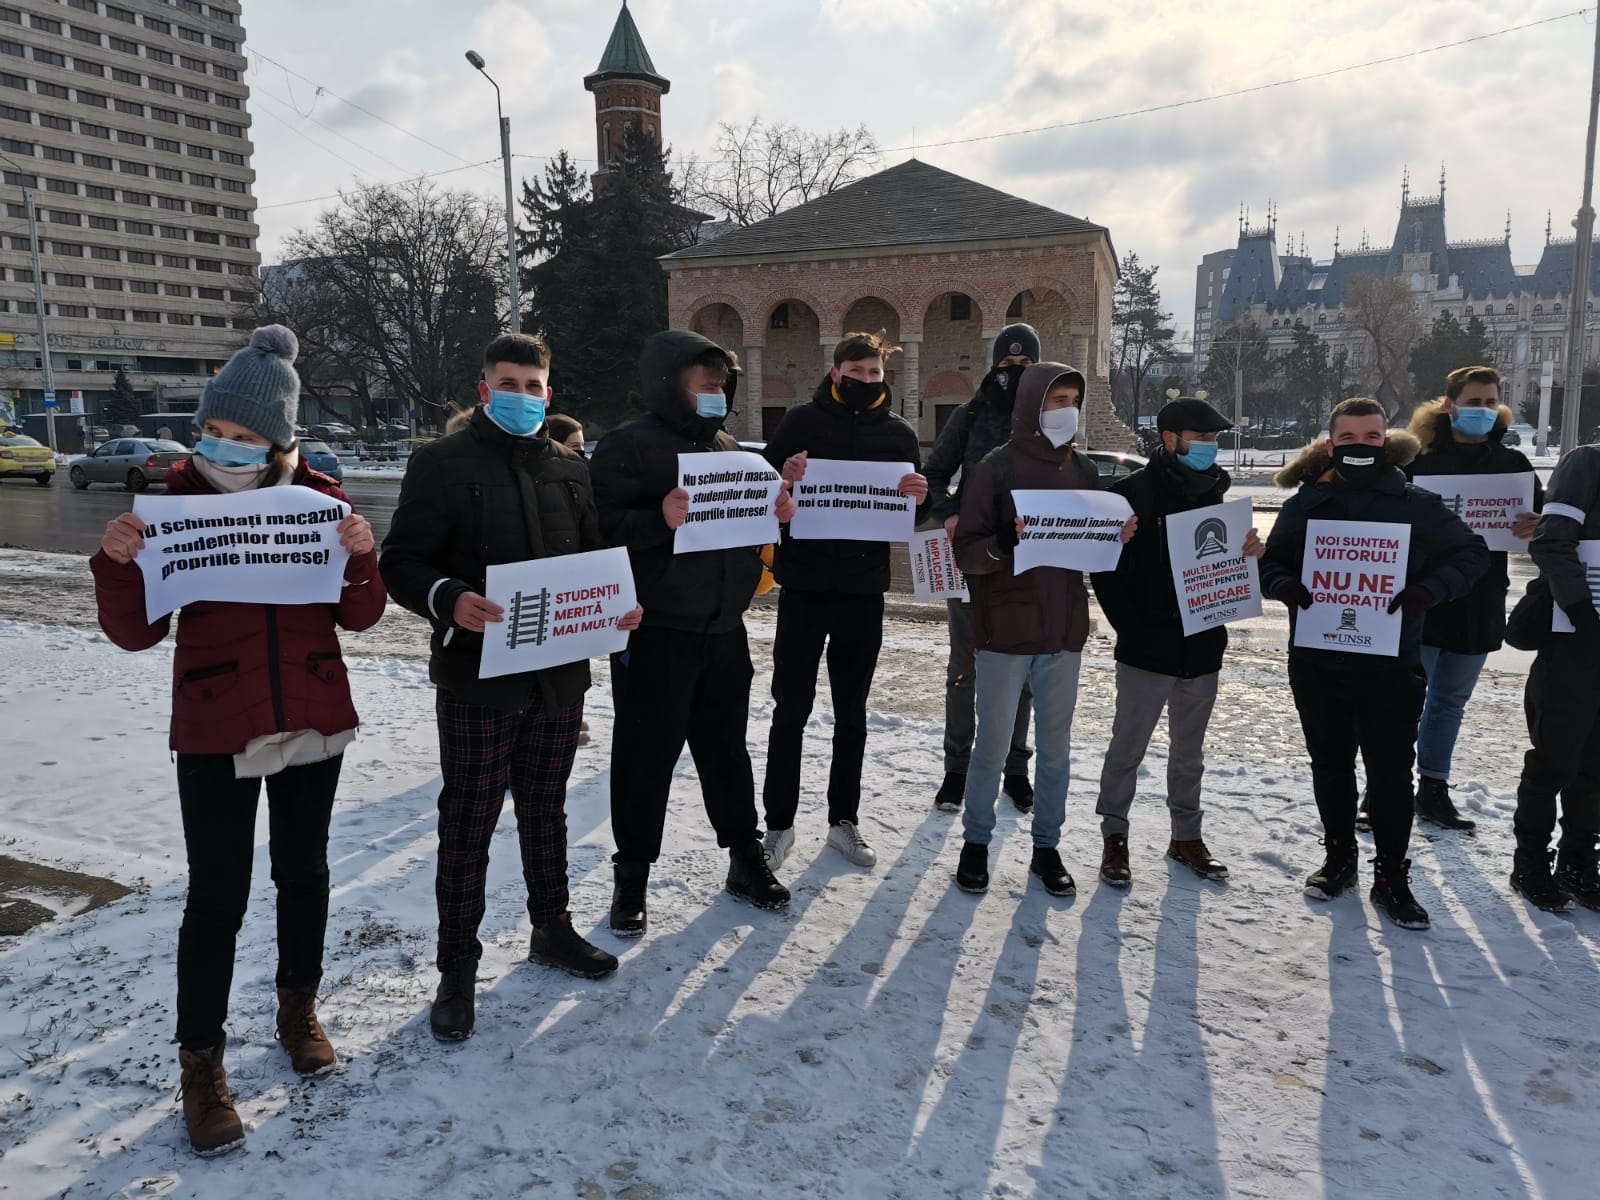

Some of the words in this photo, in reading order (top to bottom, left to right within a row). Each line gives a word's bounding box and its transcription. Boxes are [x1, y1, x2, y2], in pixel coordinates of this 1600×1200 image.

[683, 473, 697, 487] Nu
[744, 487, 768, 500] după
[800, 484, 817, 495] Voi
[819, 484, 832, 493] cu
[834, 483, 867, 495] trenul
[798, 498, 815, 508] noi
[817, 498, 830, 508] cu
[832, 498, 871, 509] dreptul
[726, 504, 768, 519] interese!
[161, 514, 262, 534] schimbați
[266, 505, 344, 525] macazul
[1023, 515, 1039, 527] Voi
[1041, 517, 1054, 527] cu
[1055, 516, 1088, 527] trenul
[1488, 521, 1515, 529] MUL
[162, 532, 270, 554] studenților
[274, 531, 321, 546] după
[1020, 531, 1032, 540] oi
[1032, 531, 1044, 540] cu
[1045, 530, 1084, 541] dreptul
[1315, 535, 1339, 546] NOI
[1342, 536, 1399, 549] SUNTEM
[1315, 548, 1397, 563] VIITORUL!
[161, 551, 240, 580] propriile
[245, 549, 330, 565] interese!
[930, 538, 945, 592] IMPLICARE
[1182, 564, 1211, 579] MULTE
[1212, 556, 1247, 570] MOTIVE
[1215, 571, 1249, 586] PENTRU
[1312, 570, 1352, 591] NU
[1358, 573, 1395, 594] NE
[555, 583, 619, 605] STUDENȚII
[1187, 583, 1251, 609] IMPLICARE
[554, 600, 603, 621] MERITĂ
[1213, 607, 1238, 620] UNSR
[552, 623, 579, 637] MAI
[581, 615, 619, 631] MULT!
[1338, 633, 1372, 645] UNSR
